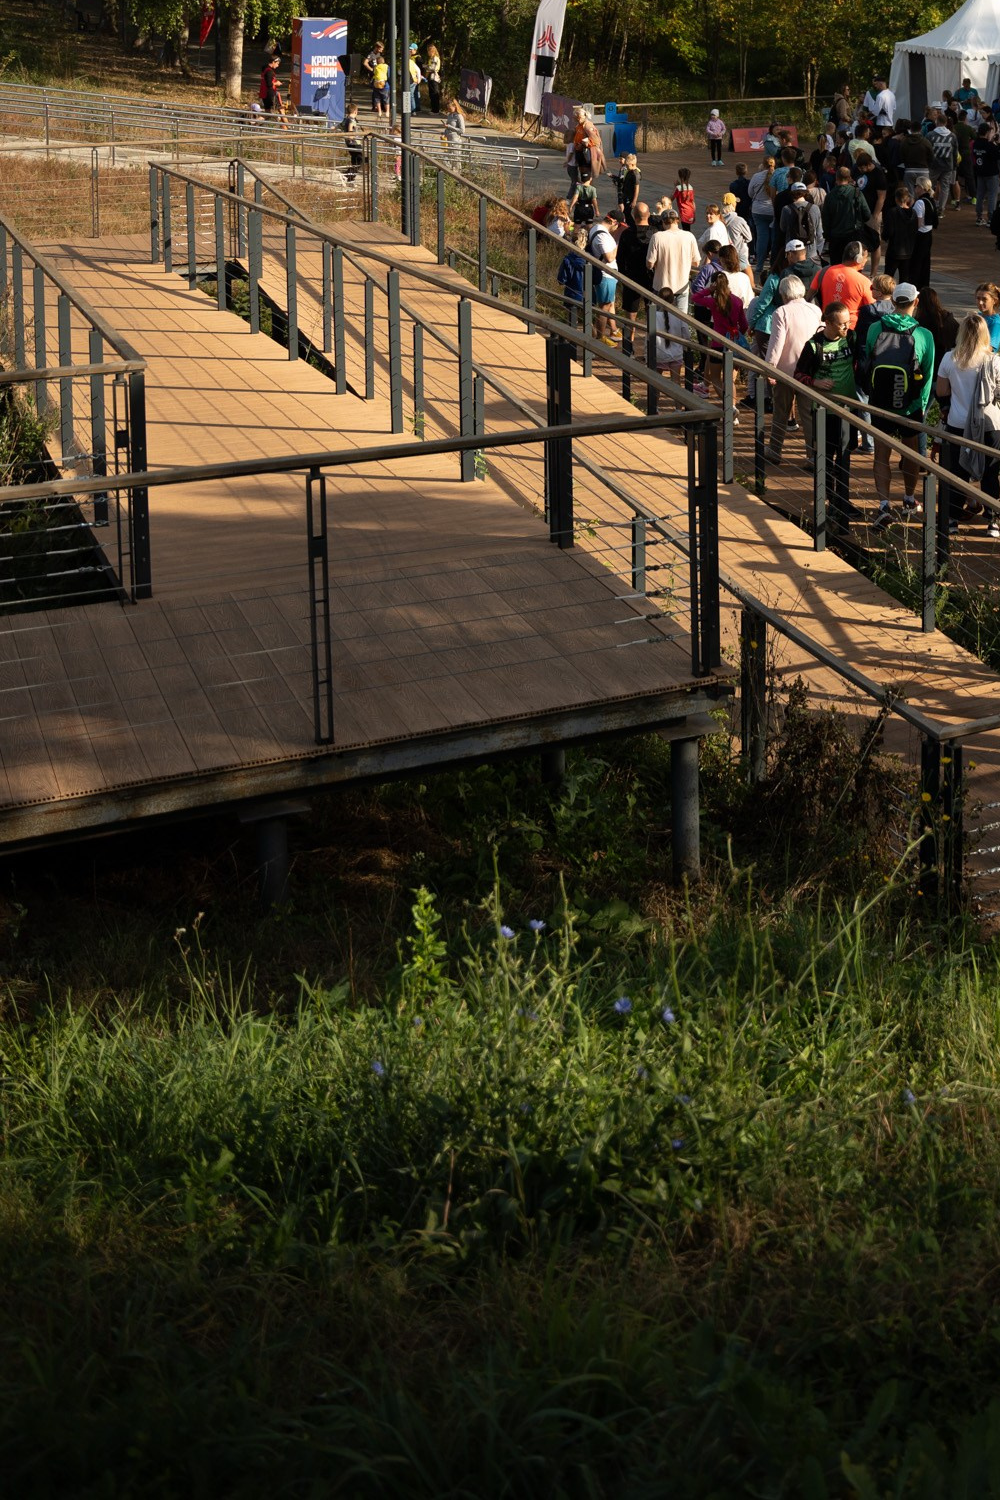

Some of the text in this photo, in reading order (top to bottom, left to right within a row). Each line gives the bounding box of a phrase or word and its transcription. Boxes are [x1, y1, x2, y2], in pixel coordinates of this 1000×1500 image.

[311, 55, 337, 67] КРОСС
[311, 67, 338, 79] НАЦИИ
[892, 373, 905, 409] arena
